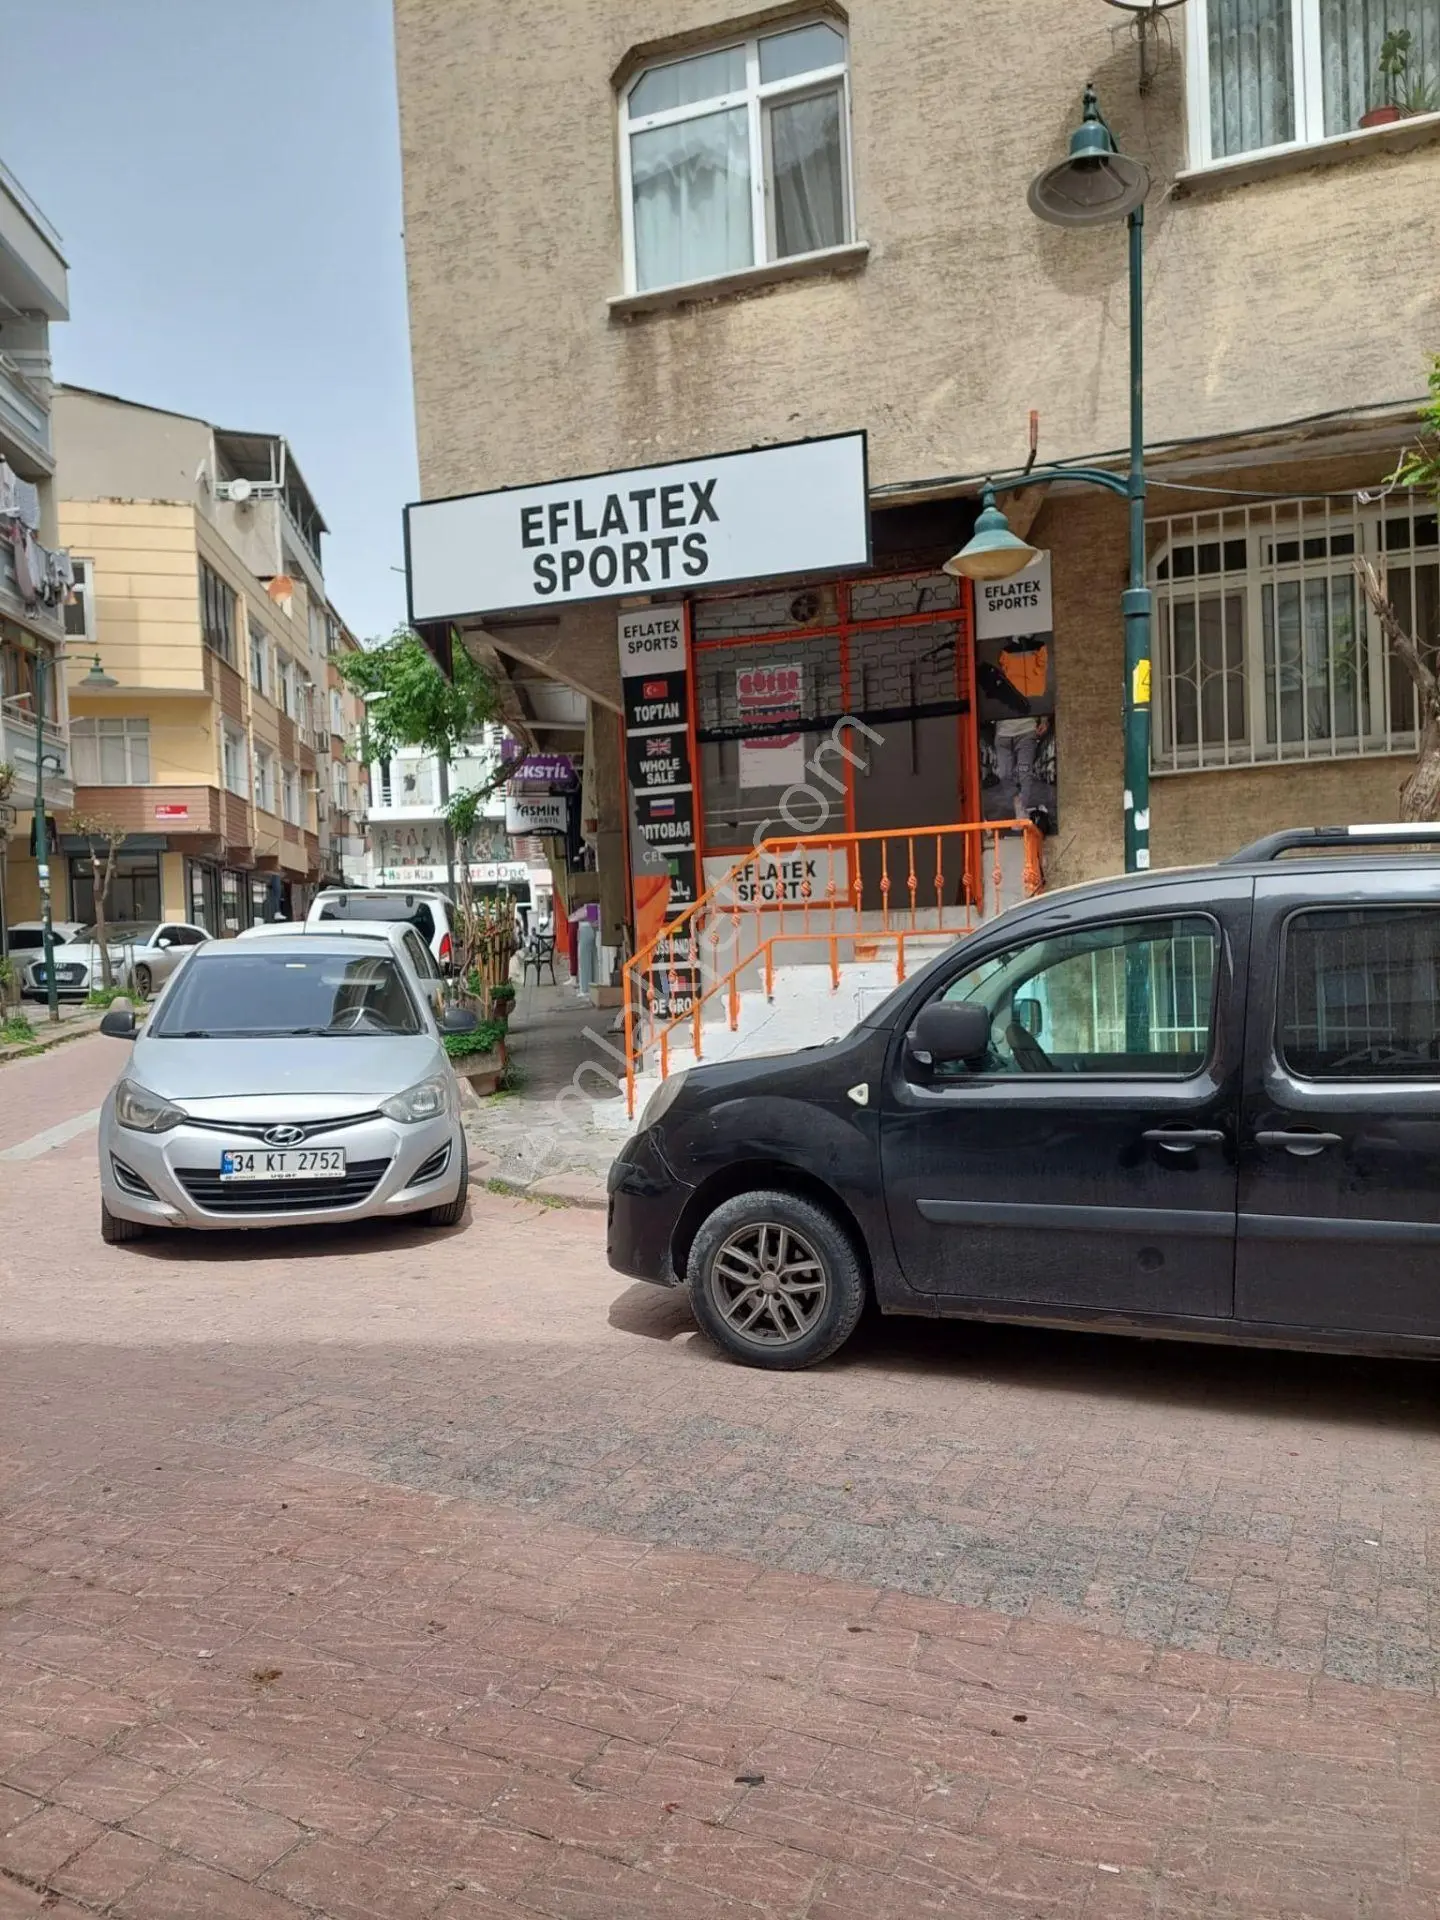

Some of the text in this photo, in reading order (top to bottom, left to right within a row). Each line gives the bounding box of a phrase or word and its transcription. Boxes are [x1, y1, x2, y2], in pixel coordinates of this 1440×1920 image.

[520, 478, 720, 549] EFLATEX
[533, 532, 709, 595] SPORTS
[985, 580, 1041, 598] EFLATEX
[989, 594, 1038, 612] SPORTS
[624, 620, 680, 638] EFLATEX
[628, 636, 678, 654] SPORTS
[634, 703, 680, 722] TOPTAN
[639, 757, 681, 773] WHOLE
[646, 771, 676, 785] SALE
[234, 1152, 340, 1172] 34 KT 2752
